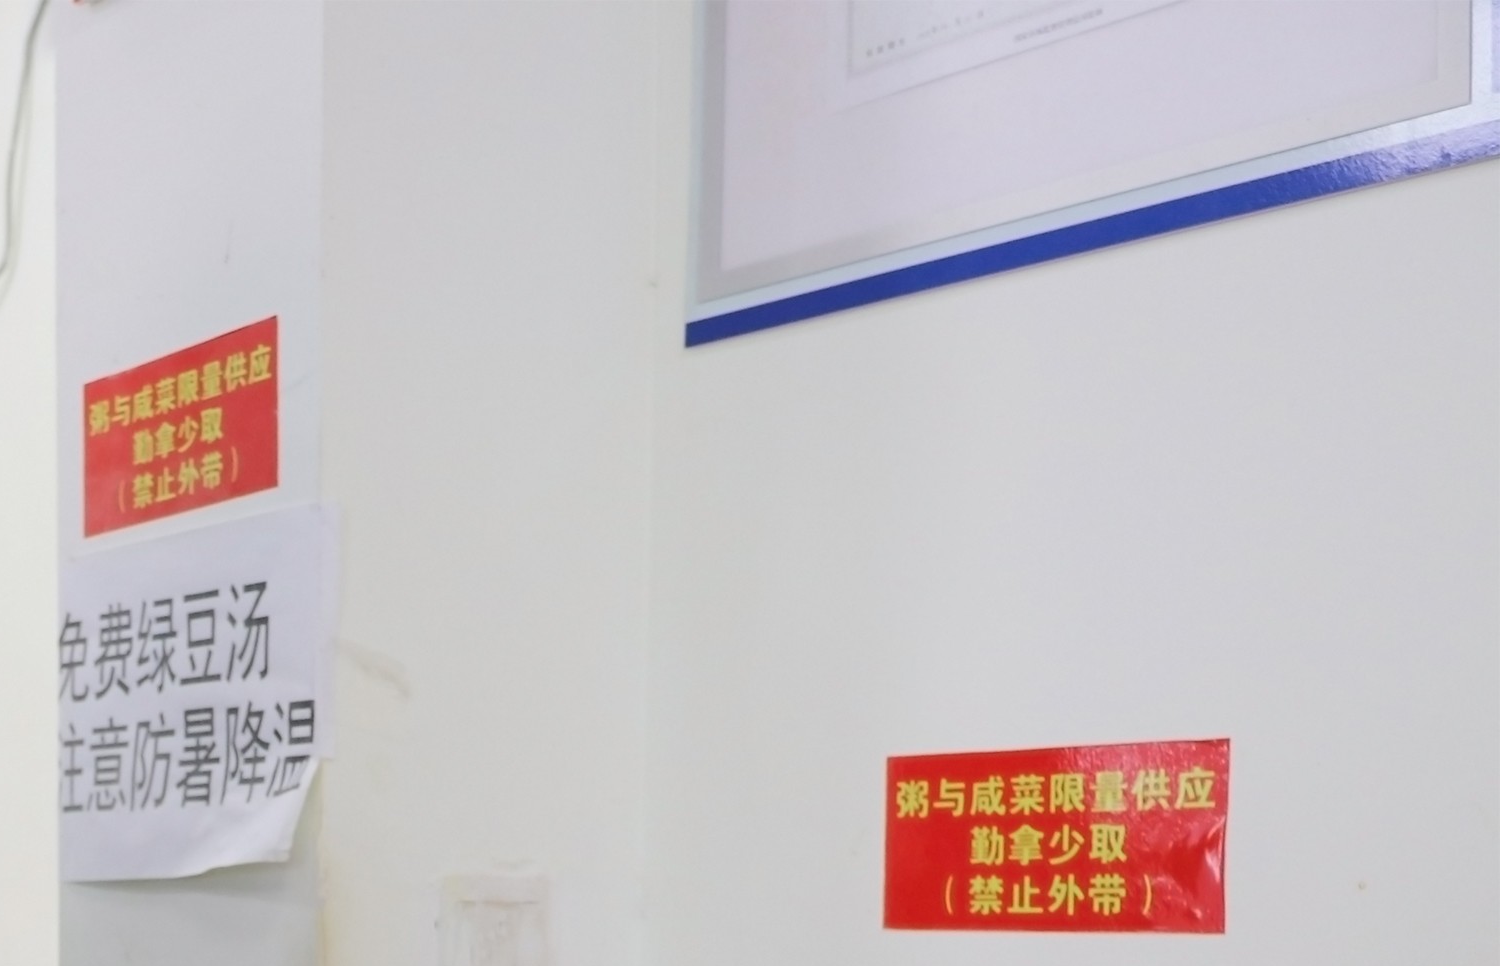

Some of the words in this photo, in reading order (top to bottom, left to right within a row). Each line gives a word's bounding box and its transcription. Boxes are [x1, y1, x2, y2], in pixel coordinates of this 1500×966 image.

[89, 344, 272, 436] 粥与咸菜限量供应
[133, 407, 224, 465] 勤拿少取
[58, 581, 269, 702] 免费绿豆汤
[896, 767, 1216, 818] 粥与咸菜限量供应
[970, 824, 1127, 865] 勤拿少取
